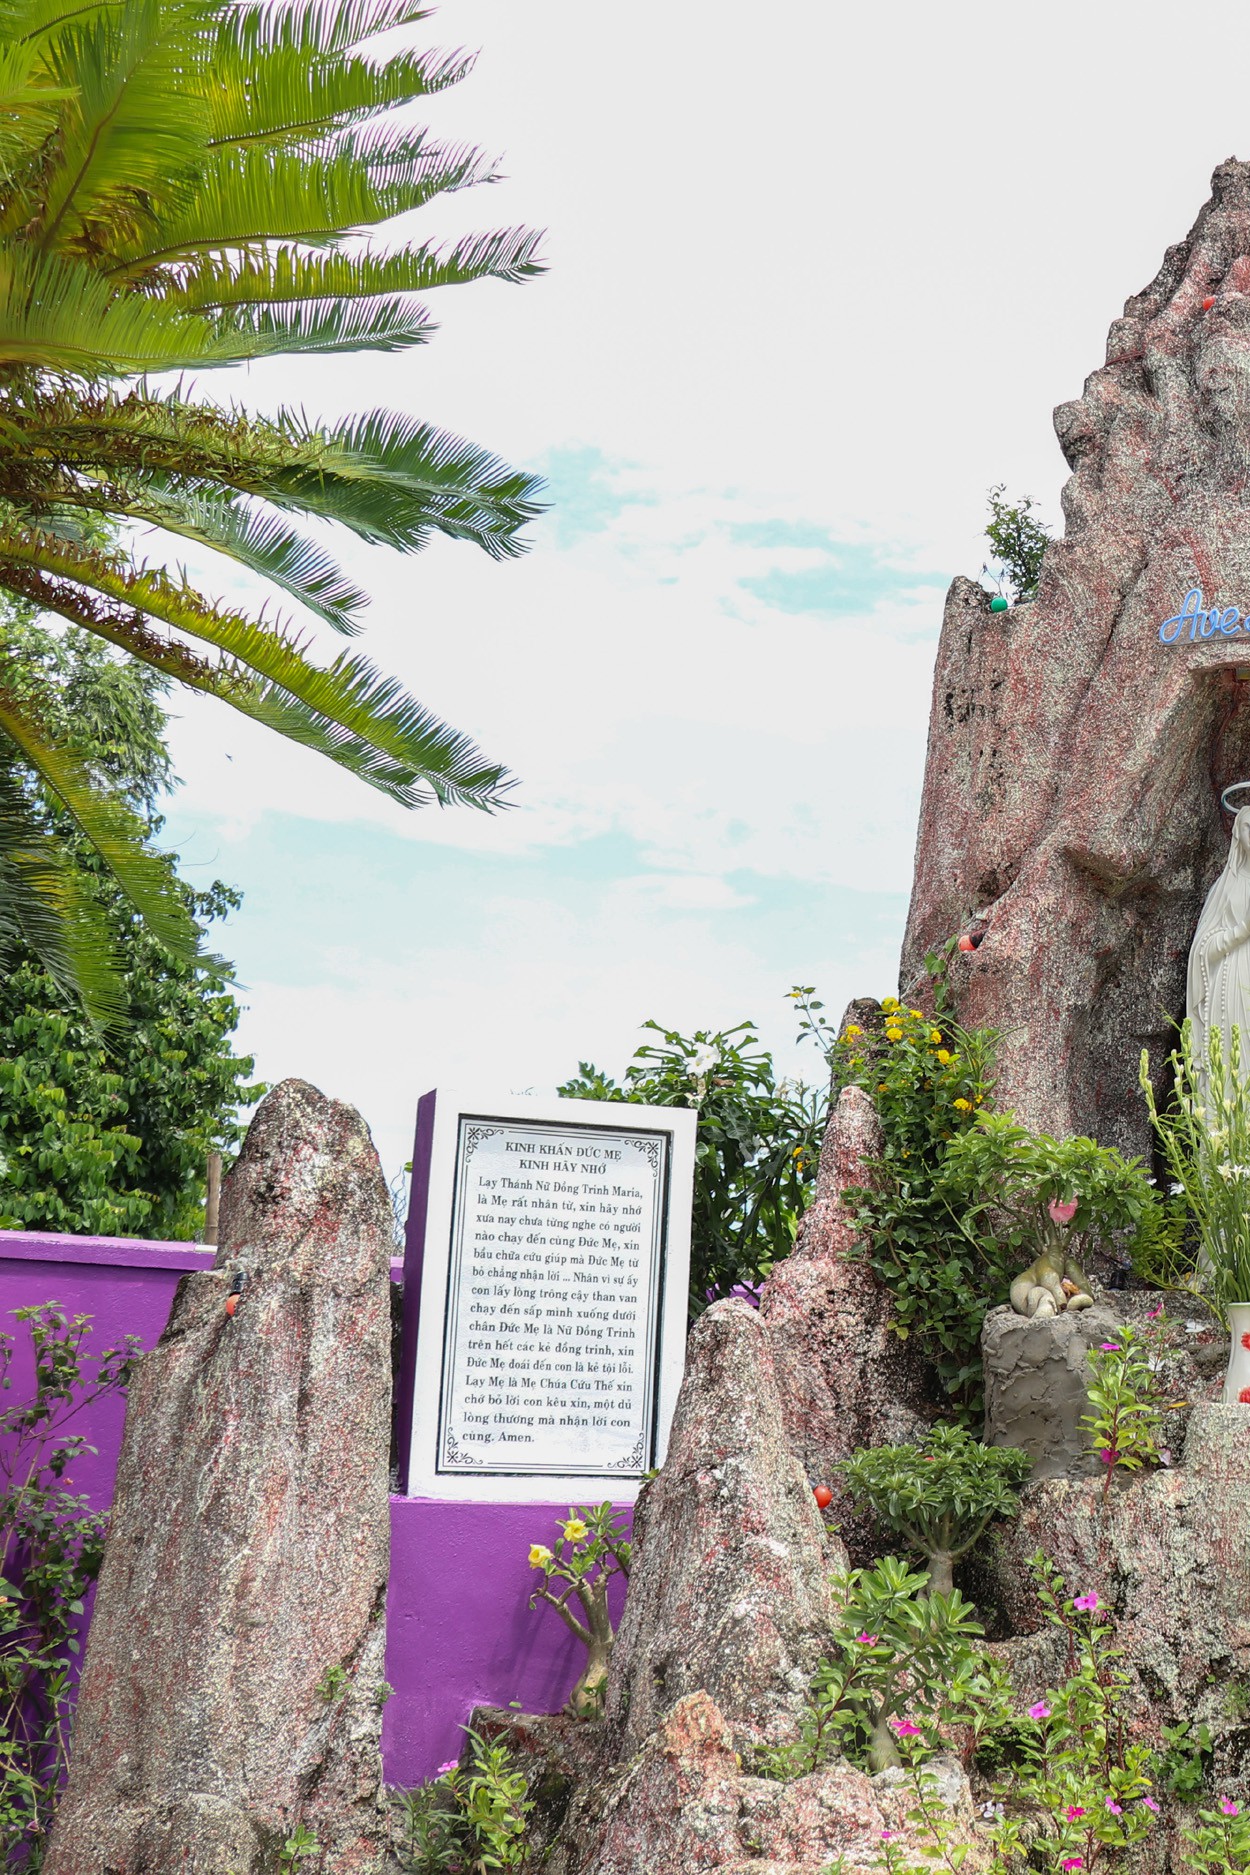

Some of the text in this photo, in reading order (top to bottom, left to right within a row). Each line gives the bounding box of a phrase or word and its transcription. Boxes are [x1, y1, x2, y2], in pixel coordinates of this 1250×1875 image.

[1159, 588, 1241, 643] Ave
[505, 1142, 536, 1154] KINH
[519, 1159, 550, 1171] KINH
[582, 1184, 609, 1196] Trinh
[579, 1202, 596, 1213] xin
[498, 1216, 517, 1227] nay
[572, 1219, 596, 1232] nghe
[624, 1240, 640, 1251] xin
[471, 1287, 490, 1296] con
[592, 1291, 616, 1302] than
[619, 1295, 638, 1304] van
[606, 1327, 636, 1339] Trinh
[585, 1344, 615, 1357] trinh,
[618, 1346, 635, 1357] xin
[555, 1364, 572, 1372] con
[617, 1381, 633, 1392] xin
[523, 1399, 543, 1407] con
[610, 1420, 631, 1428] con
[498, 1432, 535, 1443] Amen.
